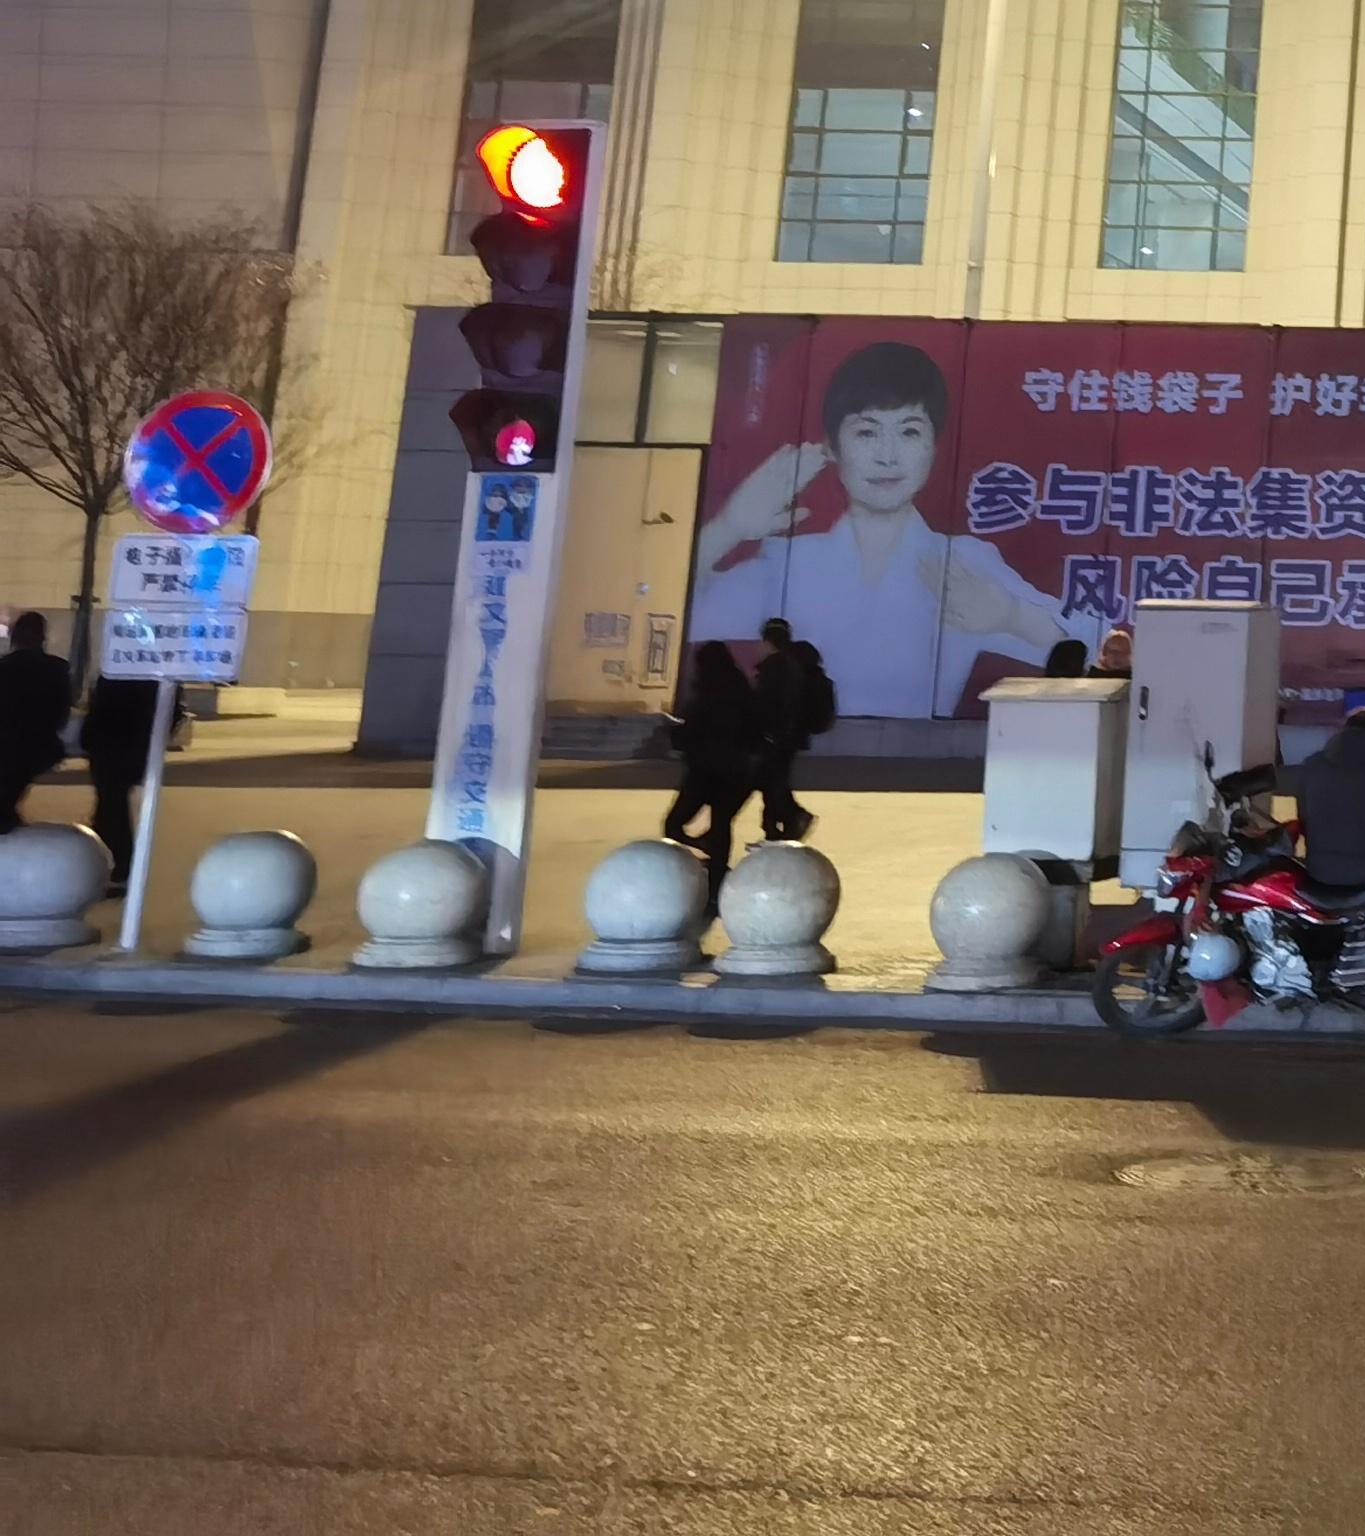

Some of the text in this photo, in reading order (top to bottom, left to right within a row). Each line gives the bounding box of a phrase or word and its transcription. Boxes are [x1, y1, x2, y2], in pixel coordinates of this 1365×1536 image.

[1021, 368, 1244, 415] 守住钱袋子
